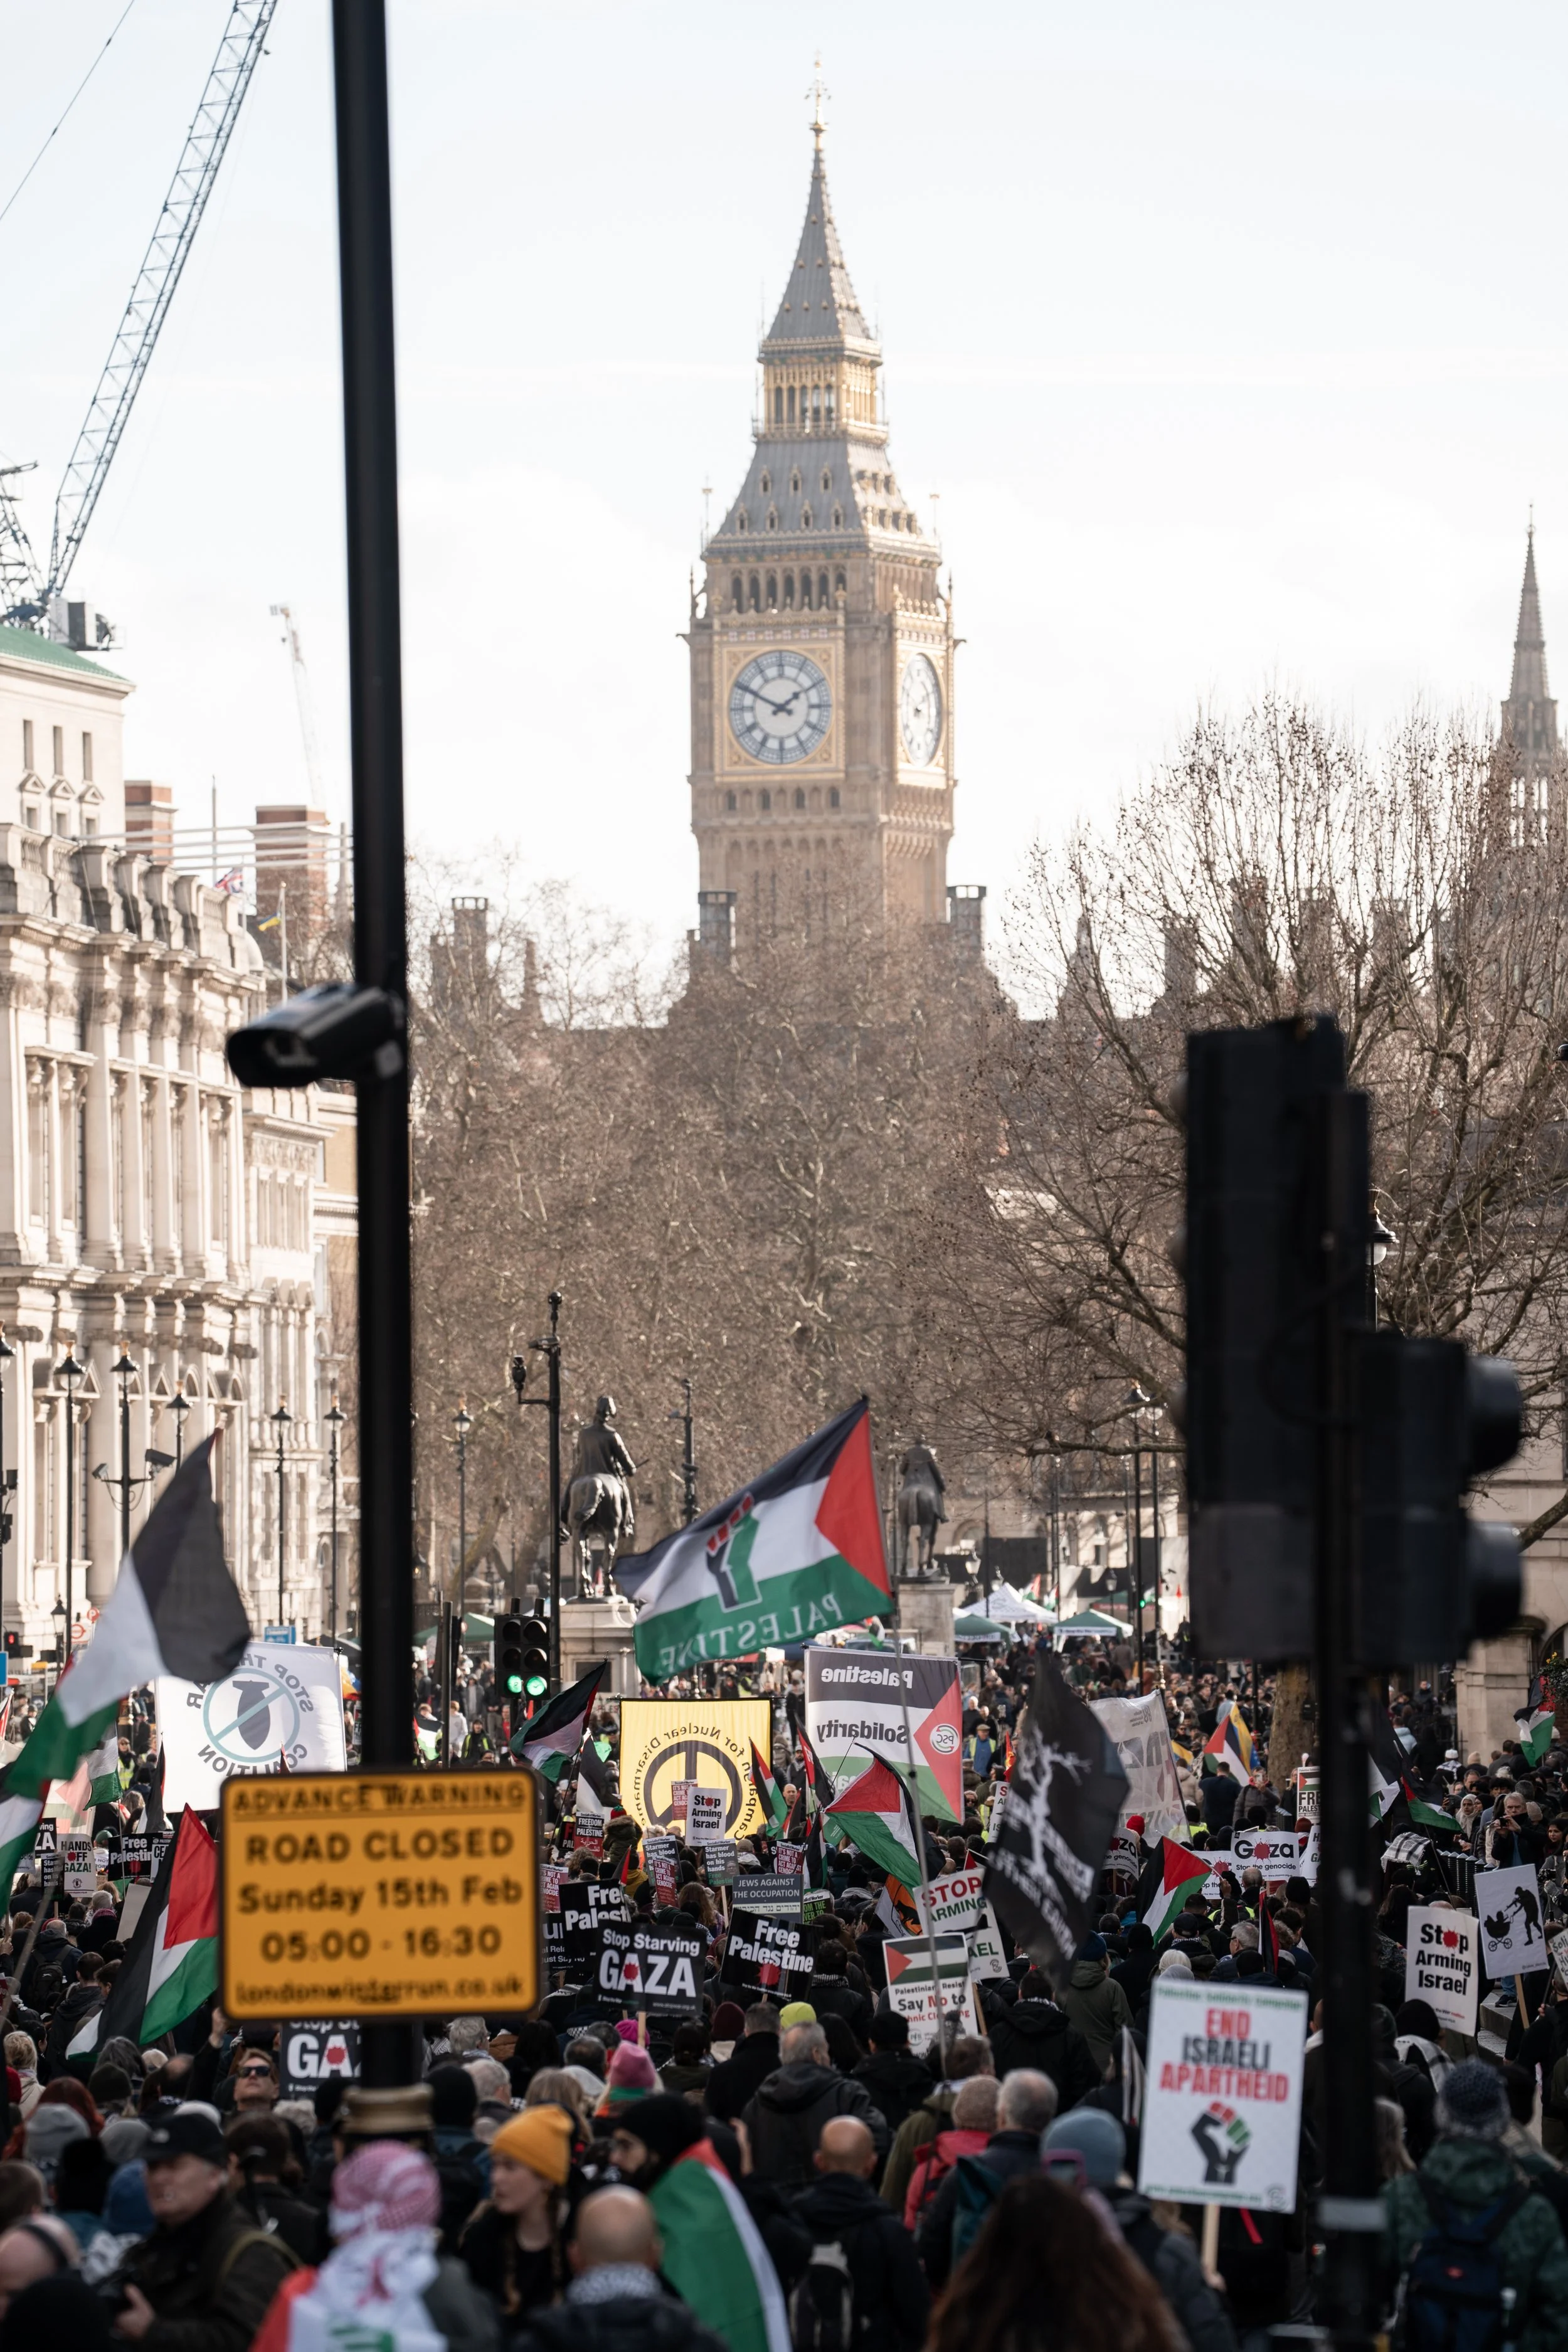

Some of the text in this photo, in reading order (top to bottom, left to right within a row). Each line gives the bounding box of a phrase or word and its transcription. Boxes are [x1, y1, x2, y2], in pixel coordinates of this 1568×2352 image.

[233, 1781, 525, 1812] ADVANCE WARNING
[1299, 1792, 1320, 1805] FRE
[578, 1818, 602, 1826] FREEDOM
[692, 1808, 722, 1820] Arming
[692, 1818, 719, 1829] Israel
[122, 1837, 147, 1849] Free
[576, 1828, 603, 1837] PALESTINE
[61, 1841, 91, 1851] HANDS
[110, 1850, 152, 1865] Palestin
[246, 1827, 514, 1865] ROAD CLOSED
[1234, 1840, 1294, 1859] Gza
[65, 1863, 91, 1872] GAZA!
[238, 1874, 523, 1917] Sunday 15th Feb
[588, 1885, 624, 1906] Fre
[750, 1890, 800, 1898] OCCUPATION
[921, 1876, 982, 1907] STOP
[565, 1905, 632, 1931] Palest
[803, 1900, 826, 1912] OM THE
[929, 1898, 987, 1923] ARMING
[603, 1928, 700, 1957] Stop Starving
[755, 1919, 800, 1948] Free
[728, 1935, 814, 1973] Palestine
[1416, 1949, 1471, 1978] Arming
[599, 1949, 696, 1998] GAZA
[1418, 1970, 1467, 1996] Israel
[898, 1993, 966, 2012] Say No to
[906, 2013, 926, 2023] hnic
[1207, 2007, 1251, 2040] END
[287, 2033, 361, 2079] GA
[1182, 2034, 1271, 2070] ISRAELI
[1160, 2061, 1288, 2102] APARTHEID
